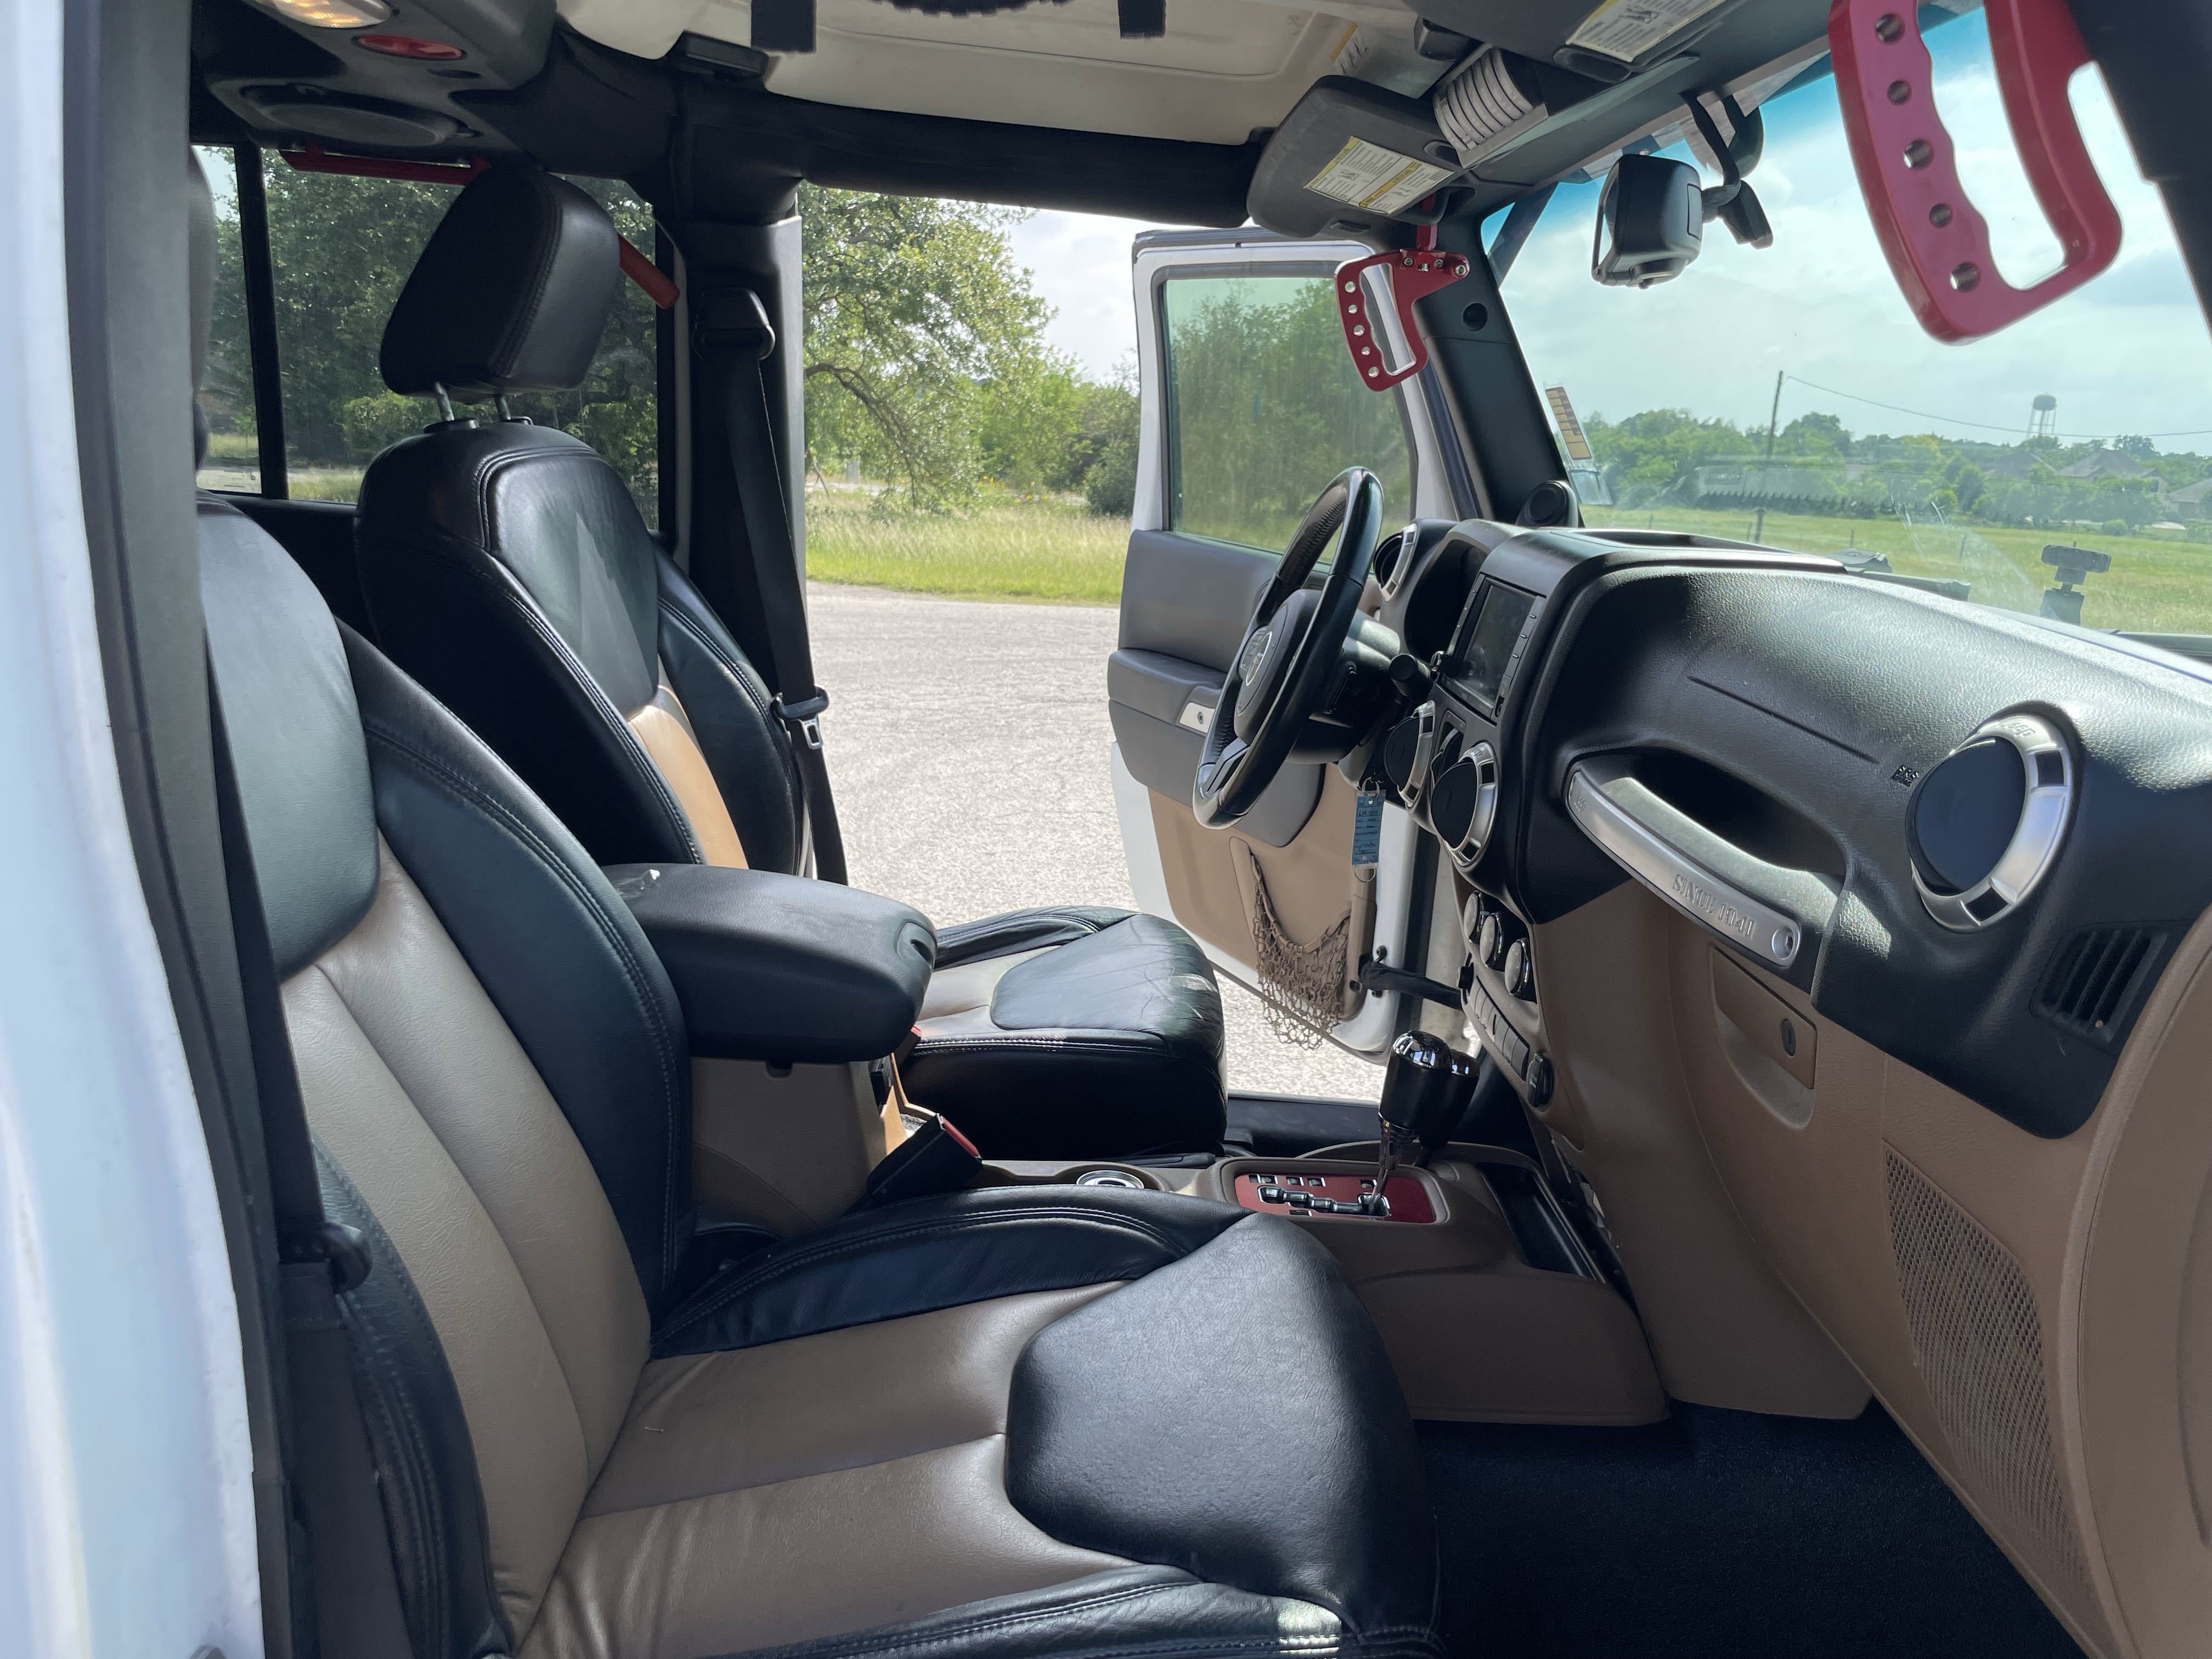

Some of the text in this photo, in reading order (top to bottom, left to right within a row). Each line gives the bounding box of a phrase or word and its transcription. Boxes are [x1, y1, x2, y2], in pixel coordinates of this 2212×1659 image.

[1997, 720, 2036, 737] Jeep
[1672, 873, 1755, 938] SINCE 1941
